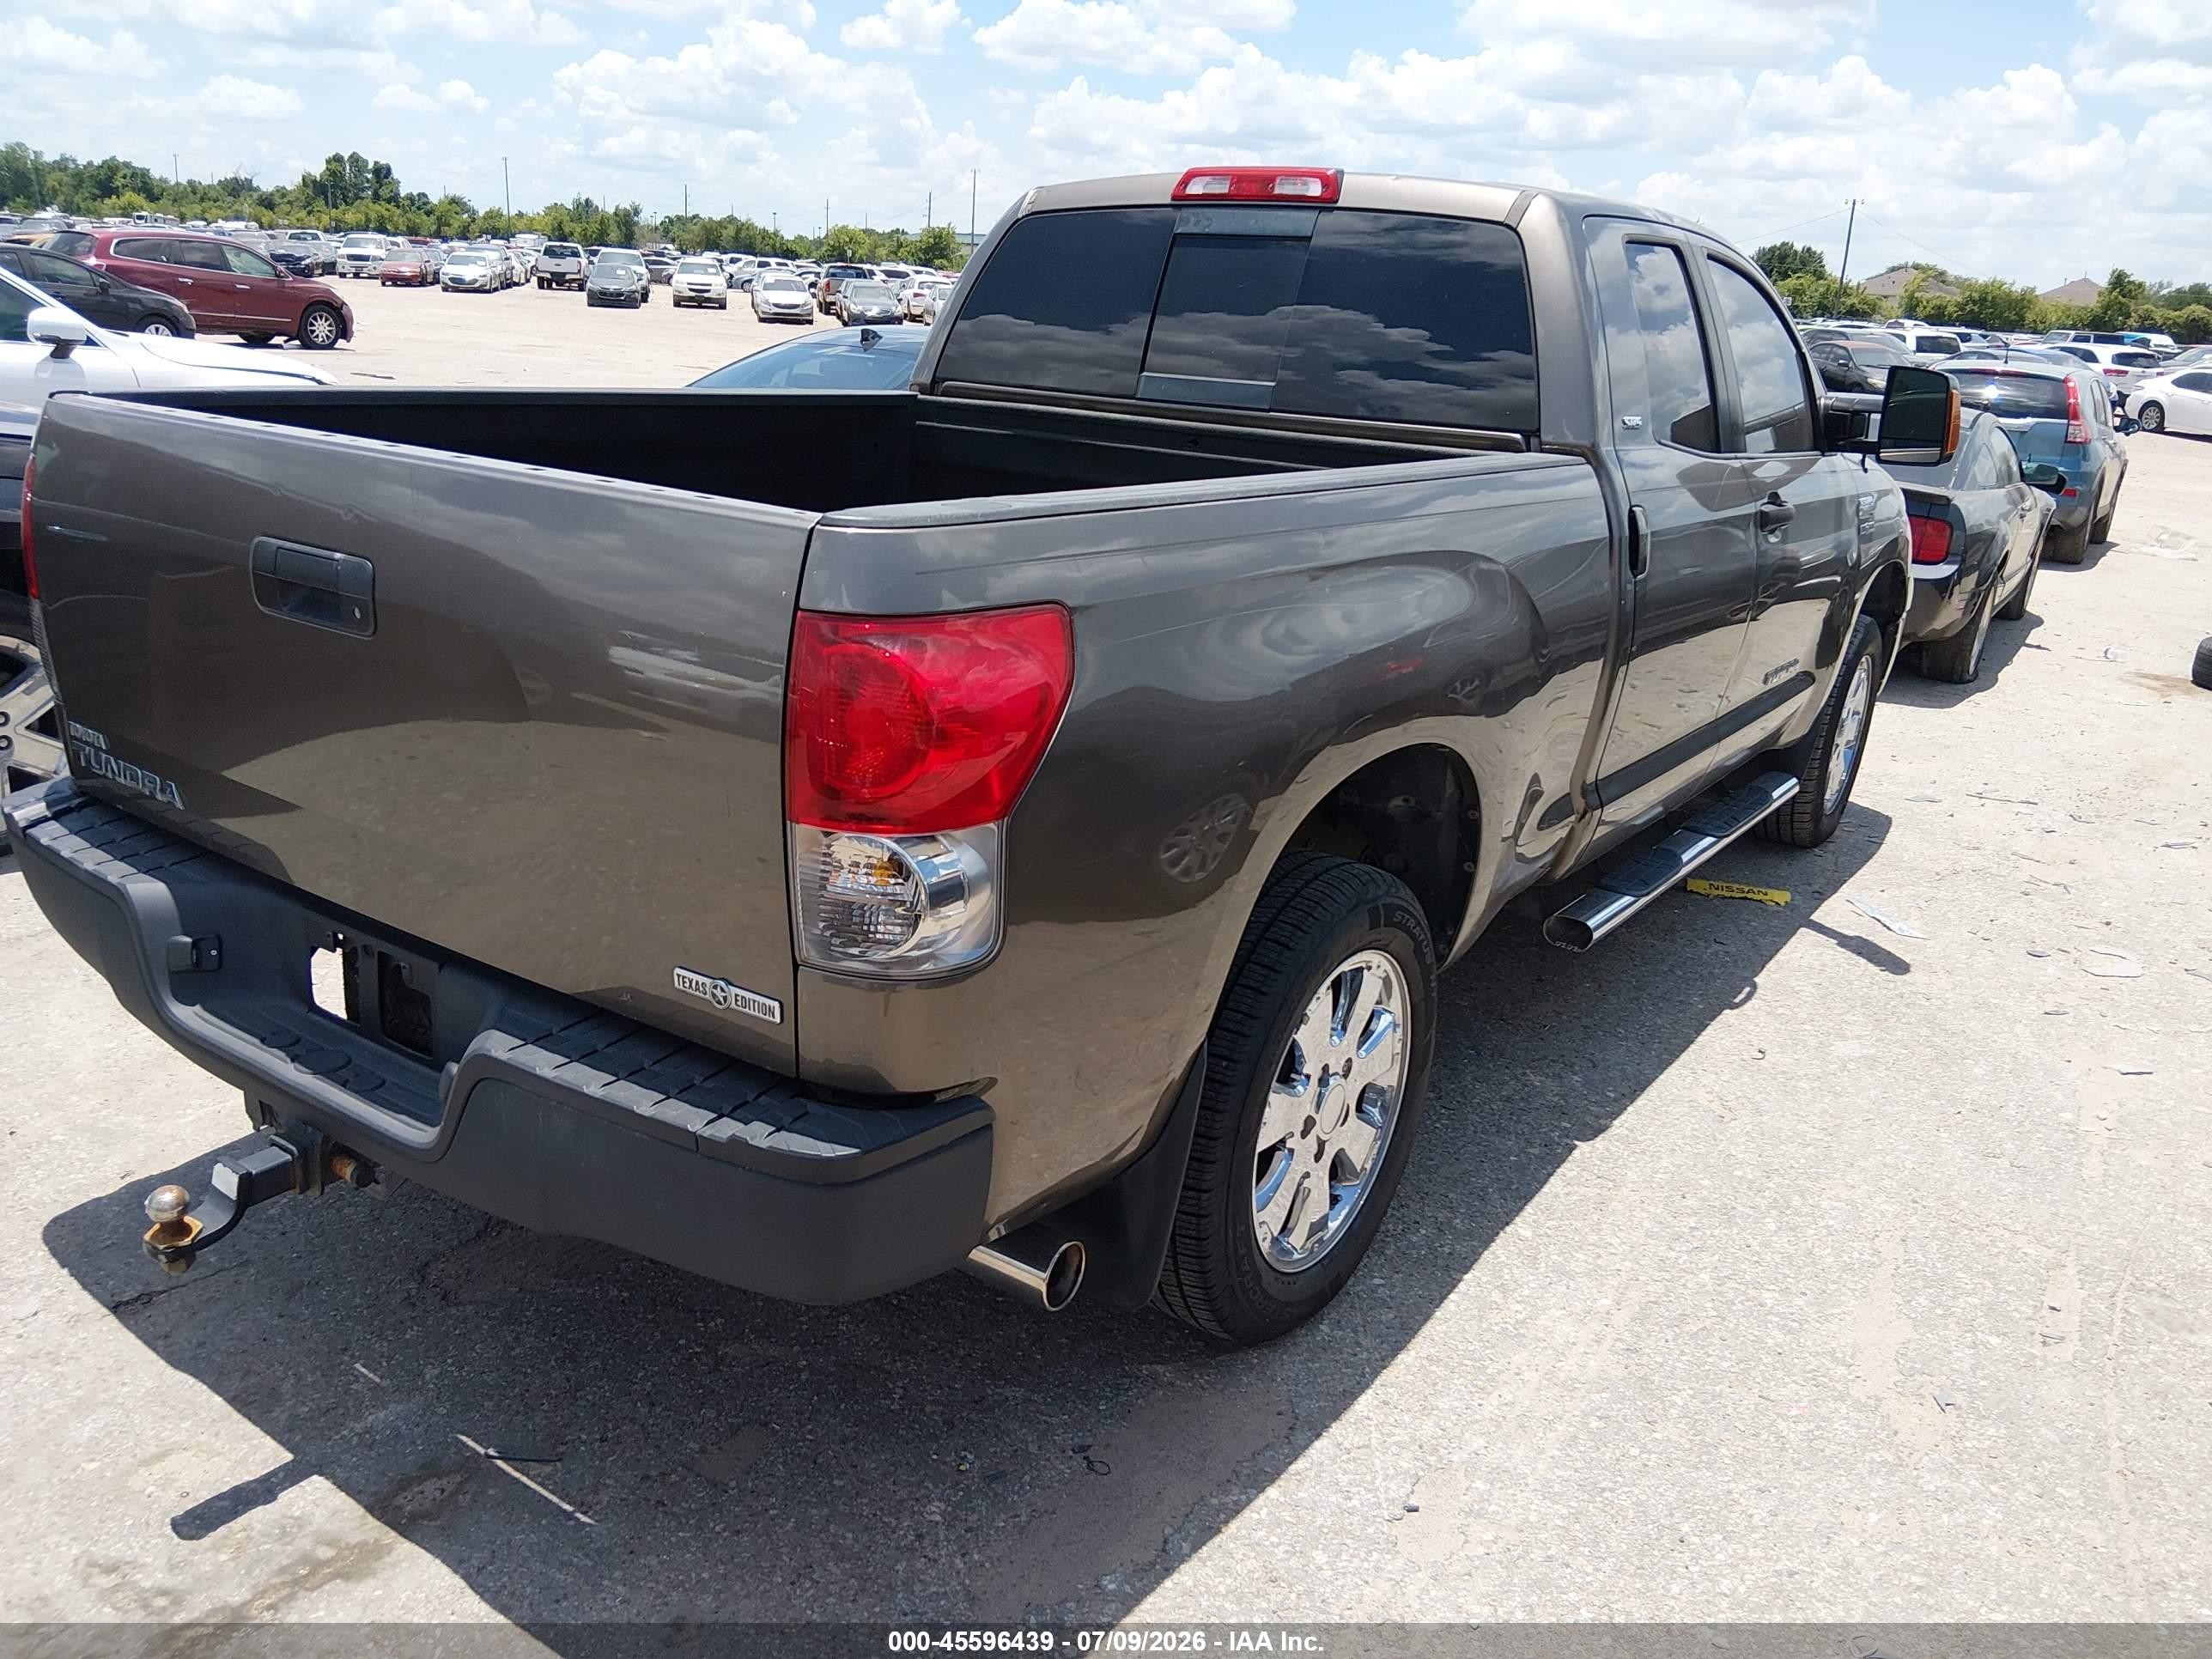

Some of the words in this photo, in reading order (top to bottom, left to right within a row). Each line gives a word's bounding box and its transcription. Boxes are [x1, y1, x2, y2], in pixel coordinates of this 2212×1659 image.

[68, 720, 109, 750] TOYOTA
[71, 740, 185, 811] TUNDRA
[1707, 882, 1769, 897] NISSAN
[675, 972, 708, 997] TEXAS
[733, 992, 777, 1020] EDITION
